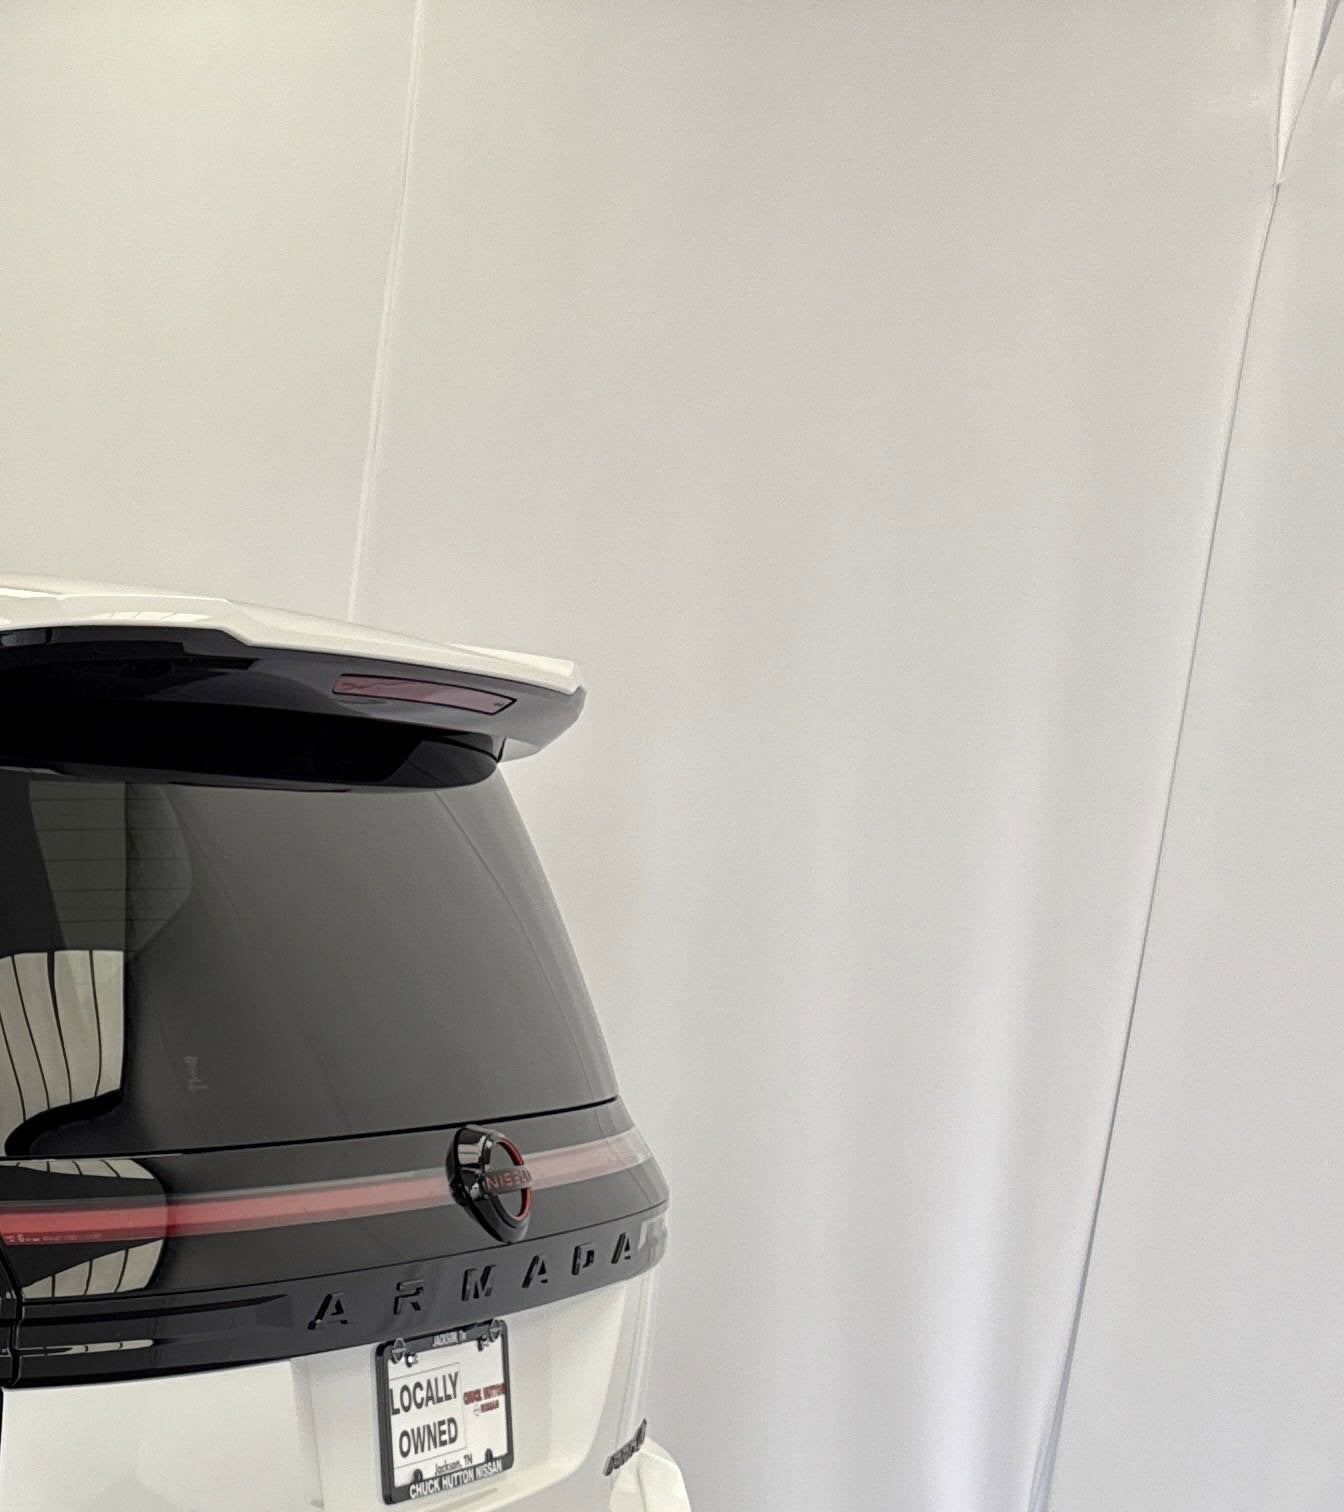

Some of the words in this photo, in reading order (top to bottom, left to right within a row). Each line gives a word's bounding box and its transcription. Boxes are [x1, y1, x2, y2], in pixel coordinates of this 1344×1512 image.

[307, 1231, 632, 1330] ARMADA
[389, 1371, 458, 1416] LOCALLY
[399, 1417, 458, 1458] OWNED
[409, 1478, 441, 1499] CHUCK
[441, 1469, 474, 1490] HUTTON
[475, 1460, 503, 1480] NISSAN
